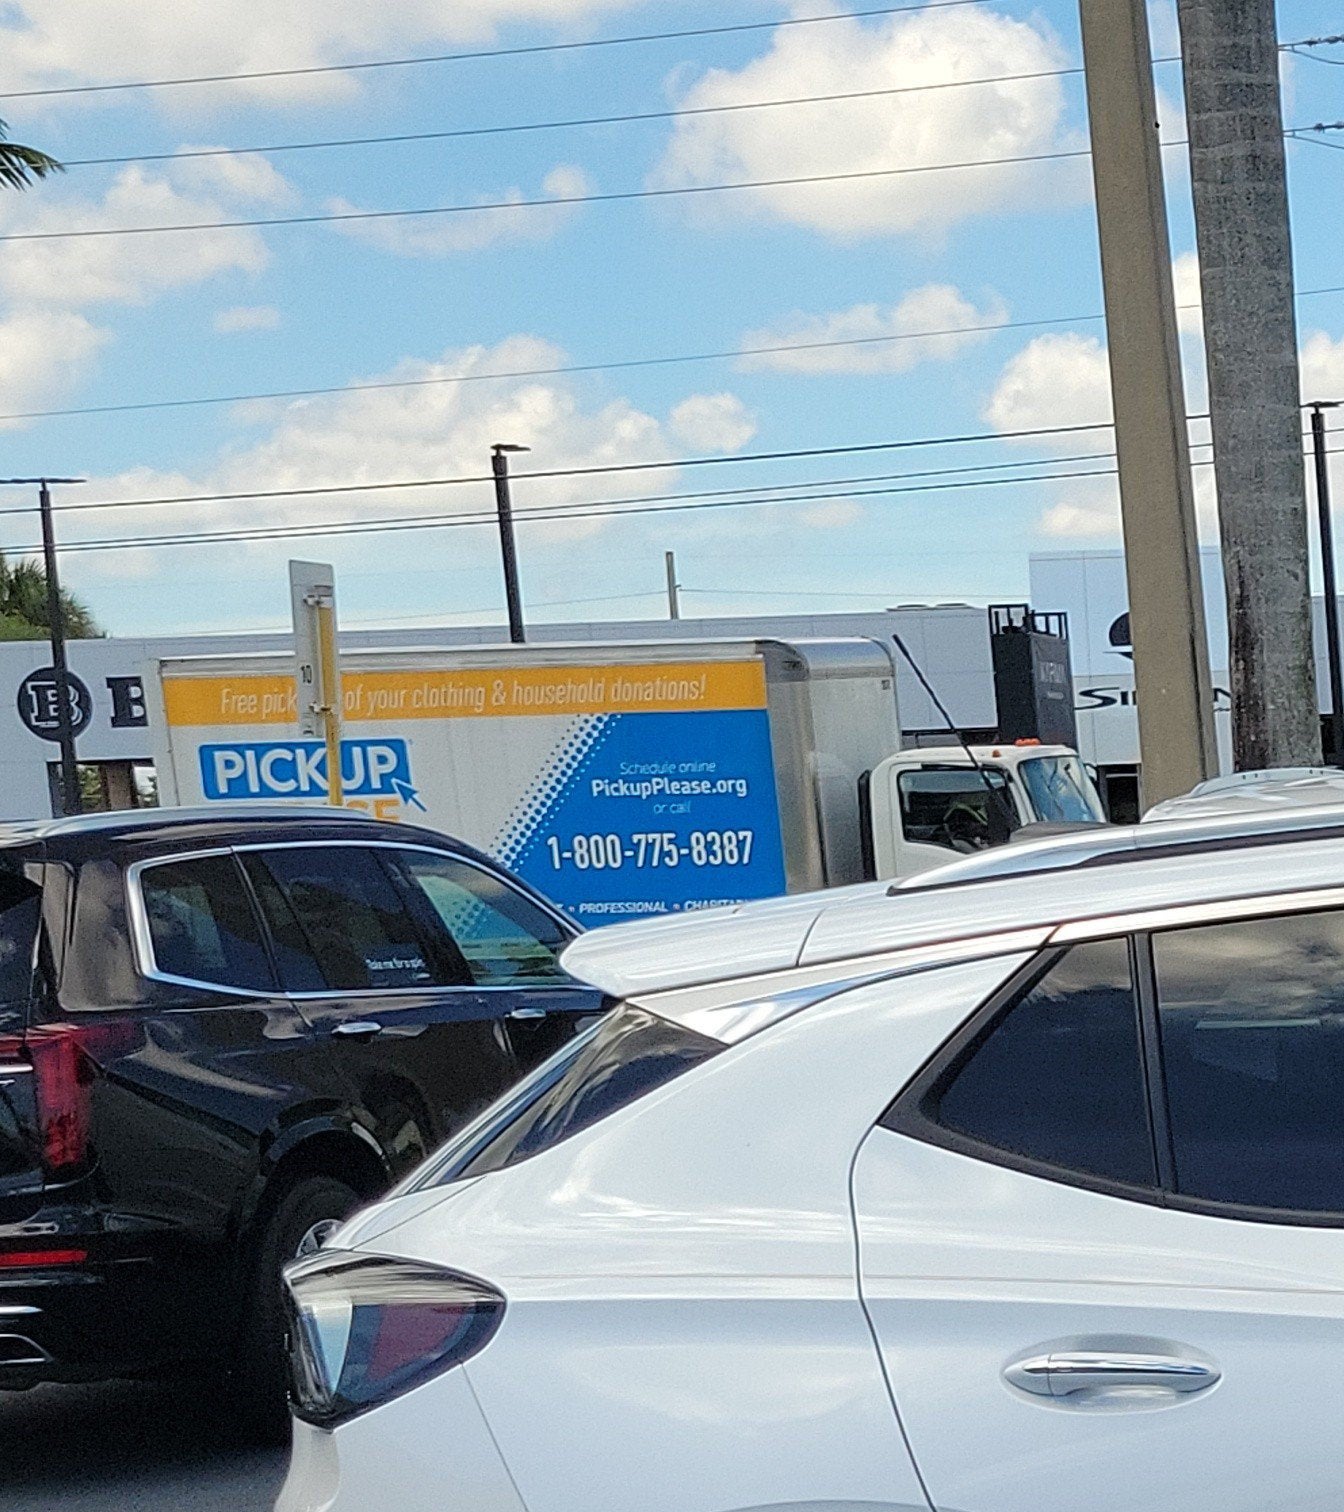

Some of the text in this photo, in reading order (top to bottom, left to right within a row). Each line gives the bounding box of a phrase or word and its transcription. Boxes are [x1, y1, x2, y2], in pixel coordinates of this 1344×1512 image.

[222, 688, 258, 714] Free
[345, 685, 365, 709] of
[367, 691, 405, 716] your
[411, 681, 486, 713] clothing
[492, 680, 506, 706] &
[513, 677, 606, 705] household
[611, 674, 707, 701] donations!
[213, 745, 398, 794] PICKUP
[619, 760, 717, 775] Schedule online
[591, 777, 747, 800] PickupPlease.org
[653, 801, 691, 814] or call
[546, 830, 753, 870] 1-800-775-8387
[579, 901, 668, 914] PROFESSIONAL
